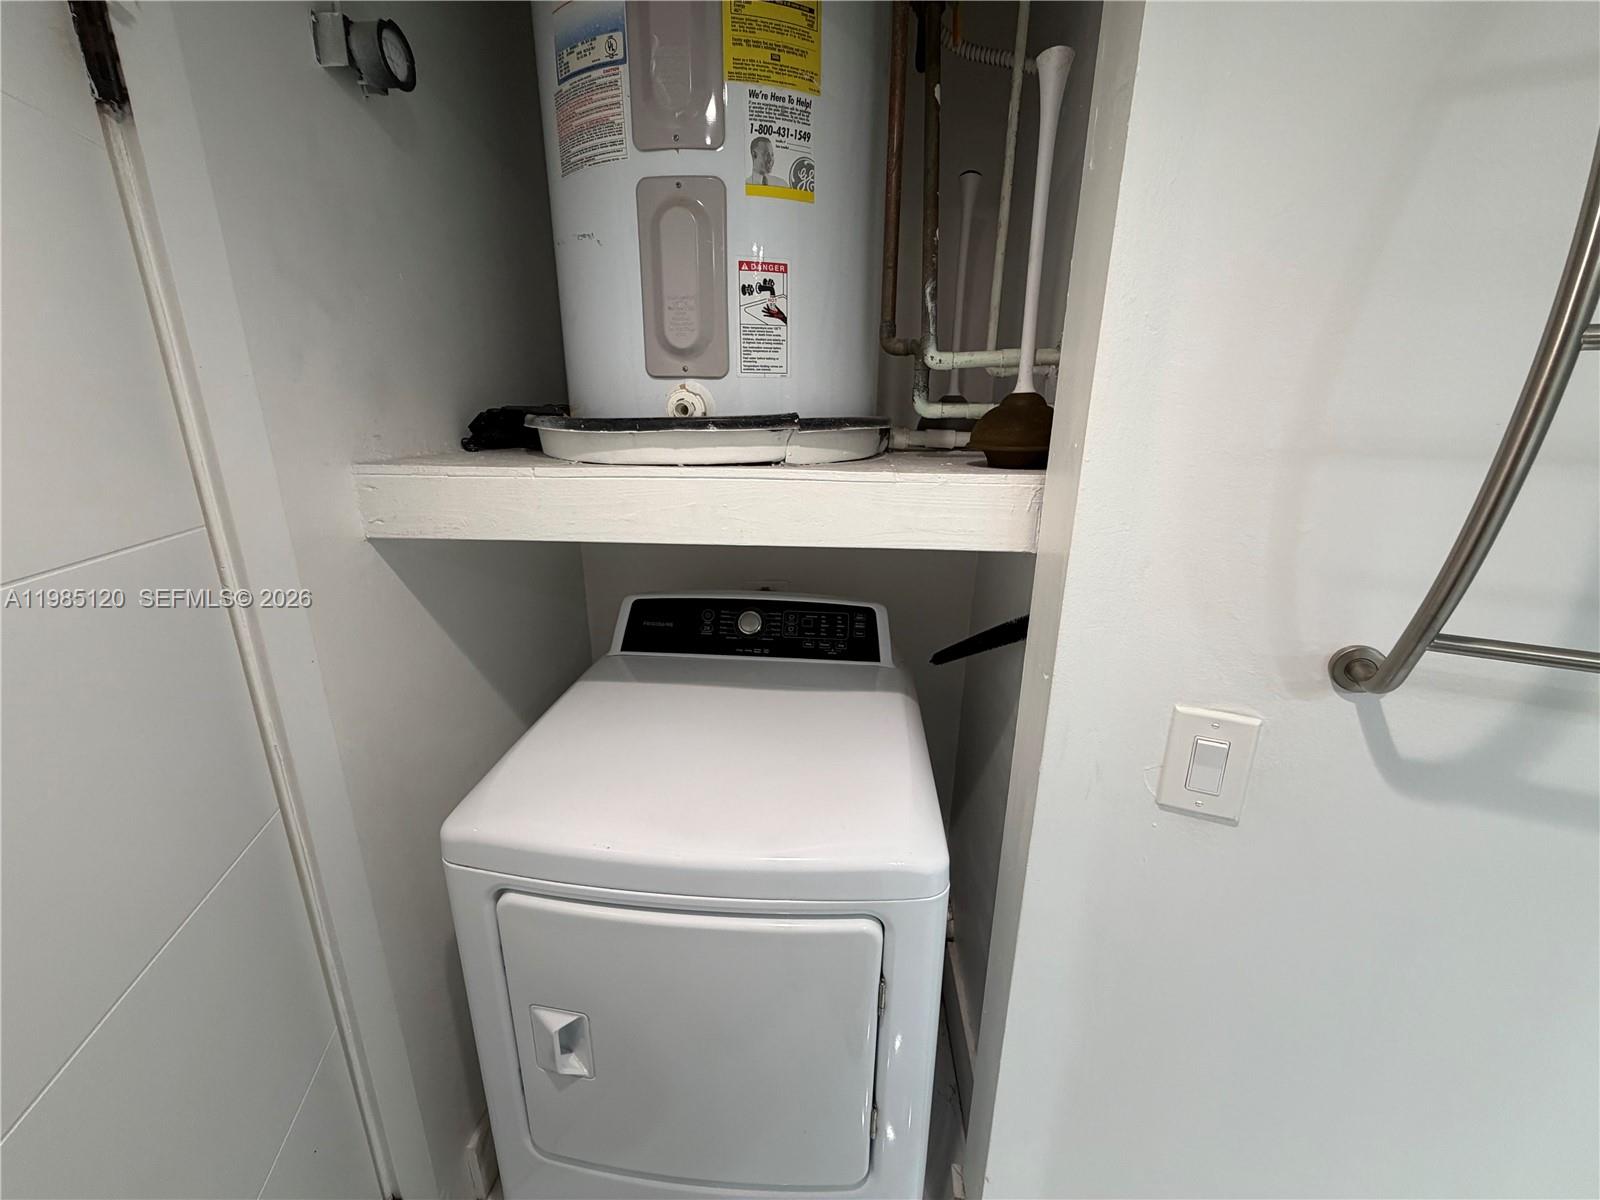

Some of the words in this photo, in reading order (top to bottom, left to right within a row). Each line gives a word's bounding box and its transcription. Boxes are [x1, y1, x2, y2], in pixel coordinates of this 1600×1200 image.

[748, 89, 768, 100] We're
[770, 92, 786, 103] Here
[788, 95, 795, 105] To
[796, 97, 812, 110] Help!
[750, 123, 812, 143] 1-800-431-1549
[750, 263, 785, 272] DANGER
